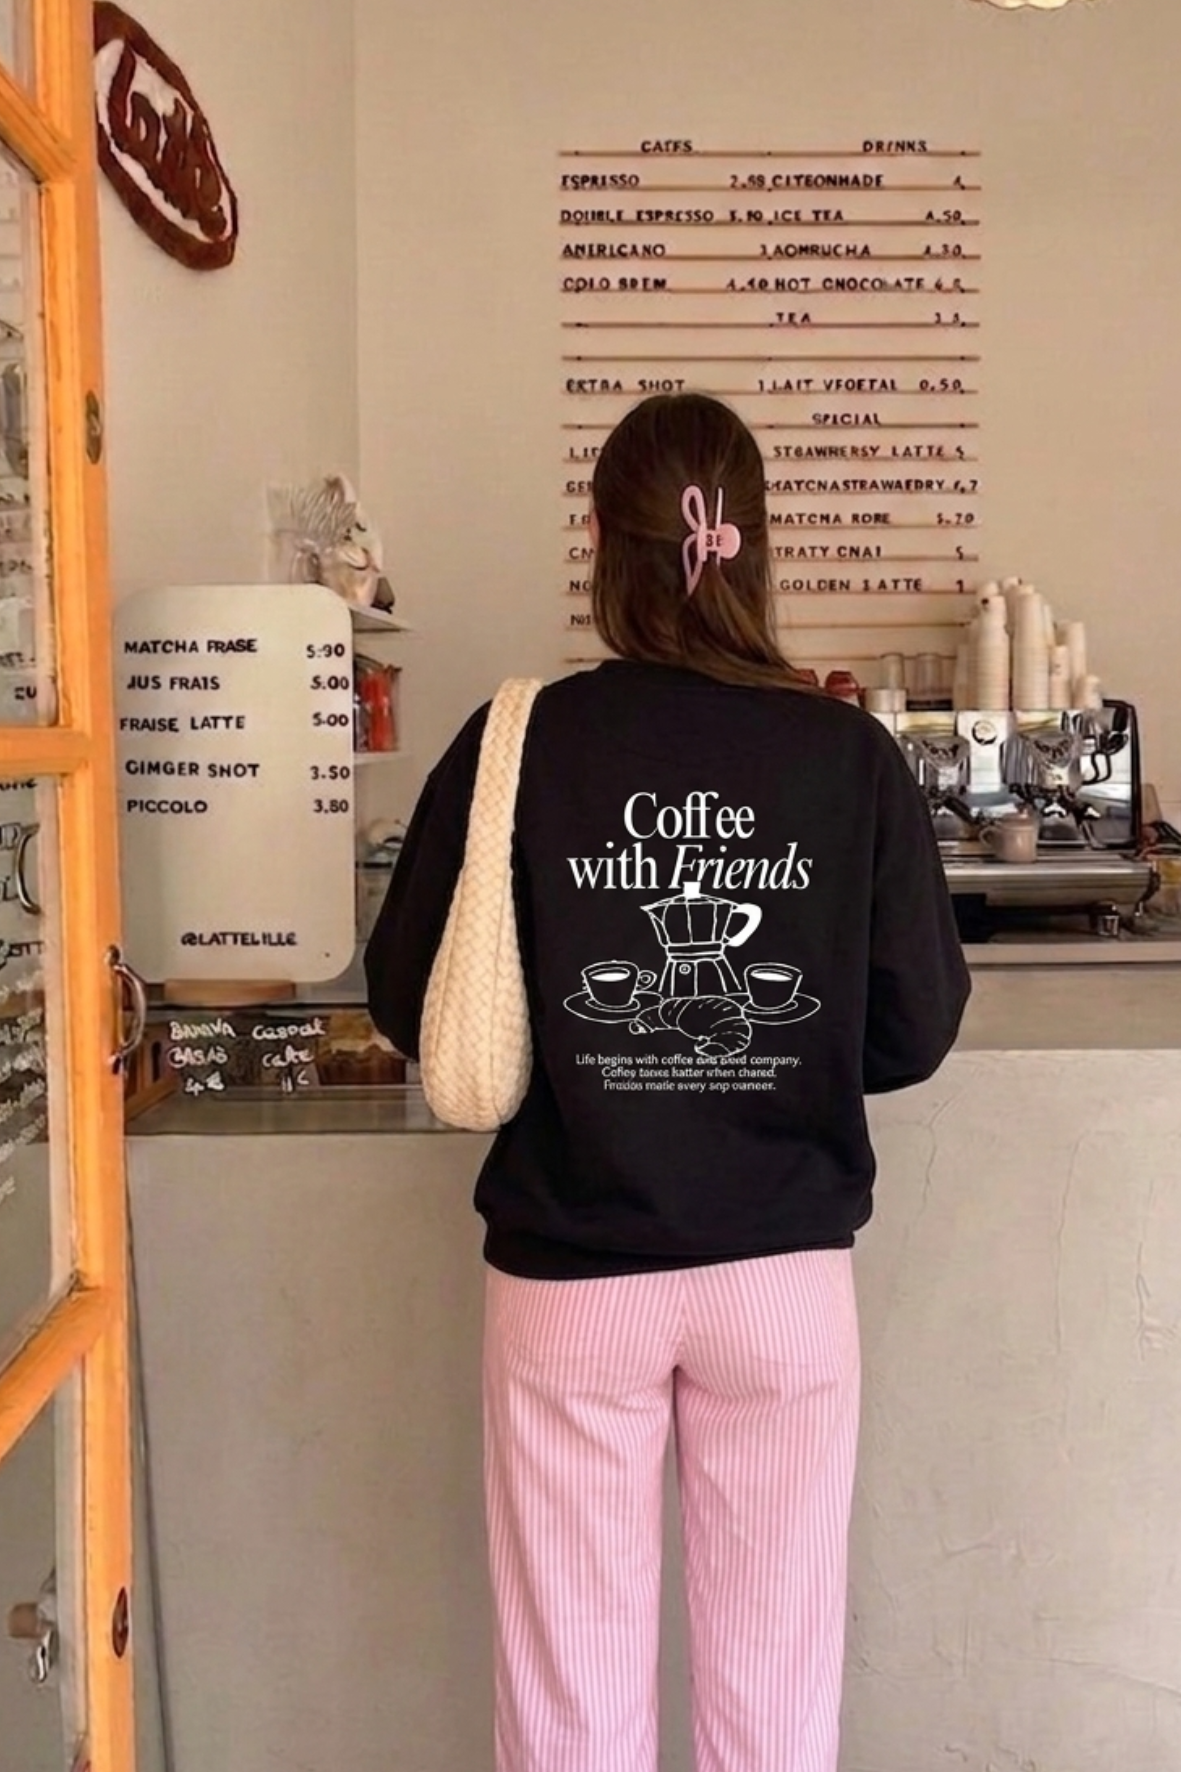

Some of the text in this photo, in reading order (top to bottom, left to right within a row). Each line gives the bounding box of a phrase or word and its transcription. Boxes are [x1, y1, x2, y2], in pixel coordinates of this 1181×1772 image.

[775, 278, 811, 291] HOT
[124, 640, 199, 654] MATCHA
[127, 676, 162, 690] JUS
[120, 717, 180, 732] FRAISE
[190, 715, 246, 731] LATTE
[310, 765, 350, 780] 3.50
[127, 799, 208, 814] PICCOLO
[623, 790, 755, 839] Coffee
[567, 841, 813, 891] with Friends
[598, 1053, 634, 1068] begins
[635, 1054, 659, 1065] with
